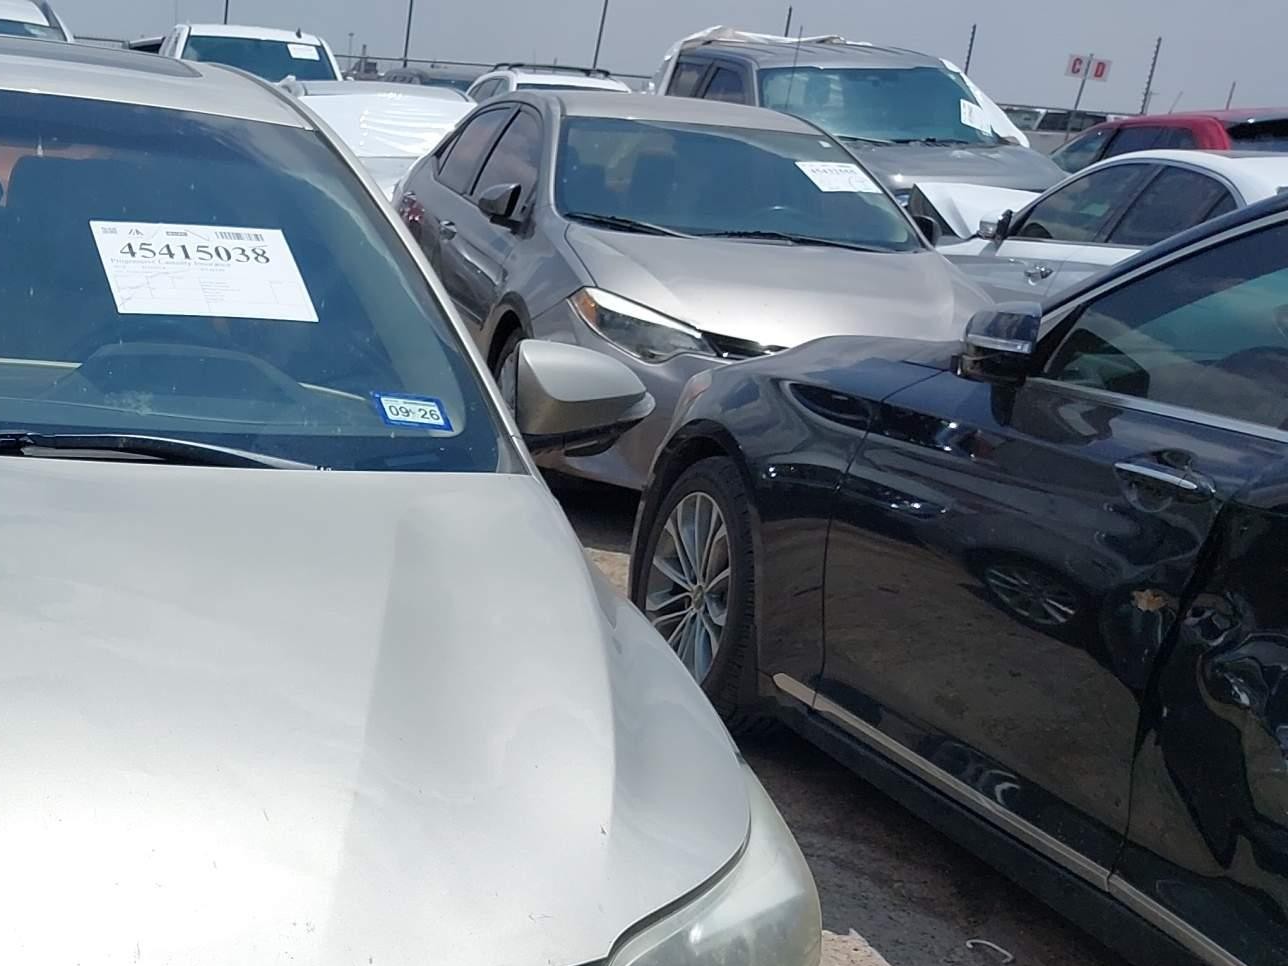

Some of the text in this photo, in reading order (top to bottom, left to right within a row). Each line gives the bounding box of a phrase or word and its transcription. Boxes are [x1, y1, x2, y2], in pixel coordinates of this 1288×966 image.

[1071, 57, 1083, 74] C
[119, 242, 271, 264] 45415038
[388, 405, 440, 421] 09 26
